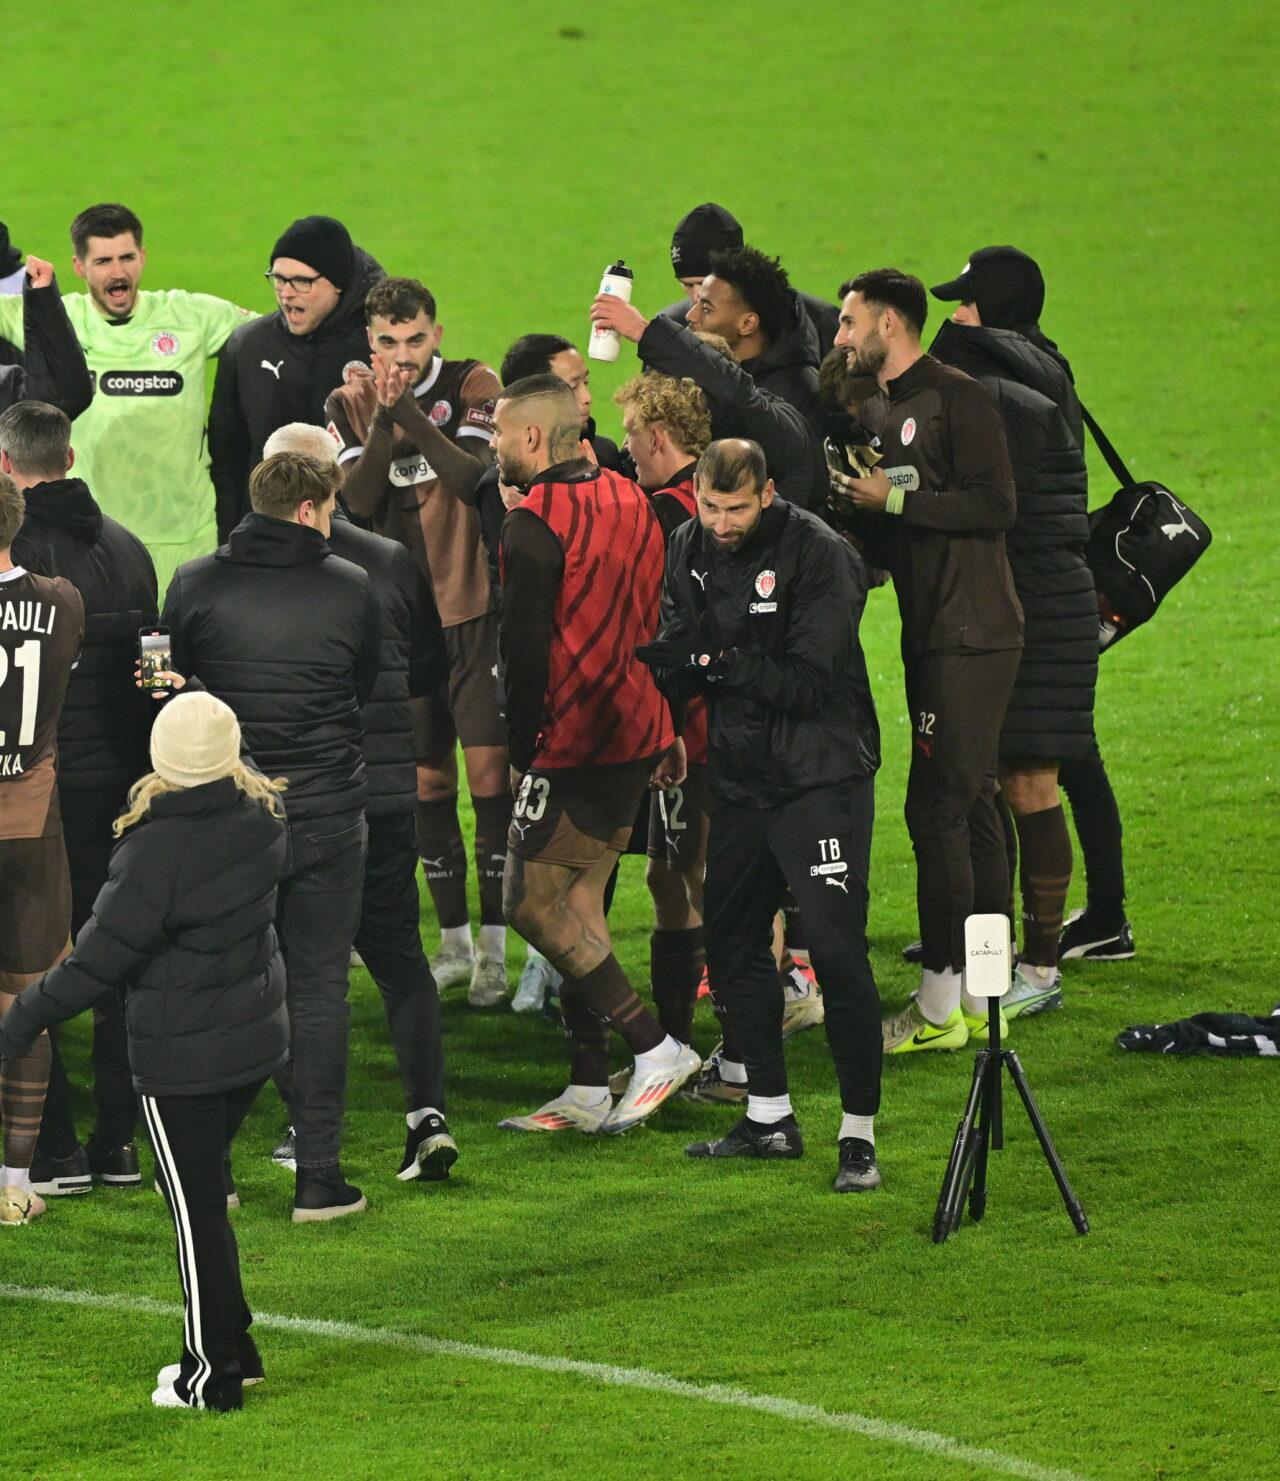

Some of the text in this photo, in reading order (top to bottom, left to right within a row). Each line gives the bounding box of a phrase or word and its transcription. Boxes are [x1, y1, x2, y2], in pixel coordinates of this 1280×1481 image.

[107, 375, 177, 393] congstar
[394, 462, 430, 477] cong
[918, 711, 936, 735] 32
[818, 838, 841, 862] TB
[970, 949, 1003, 957] CATAPULT
